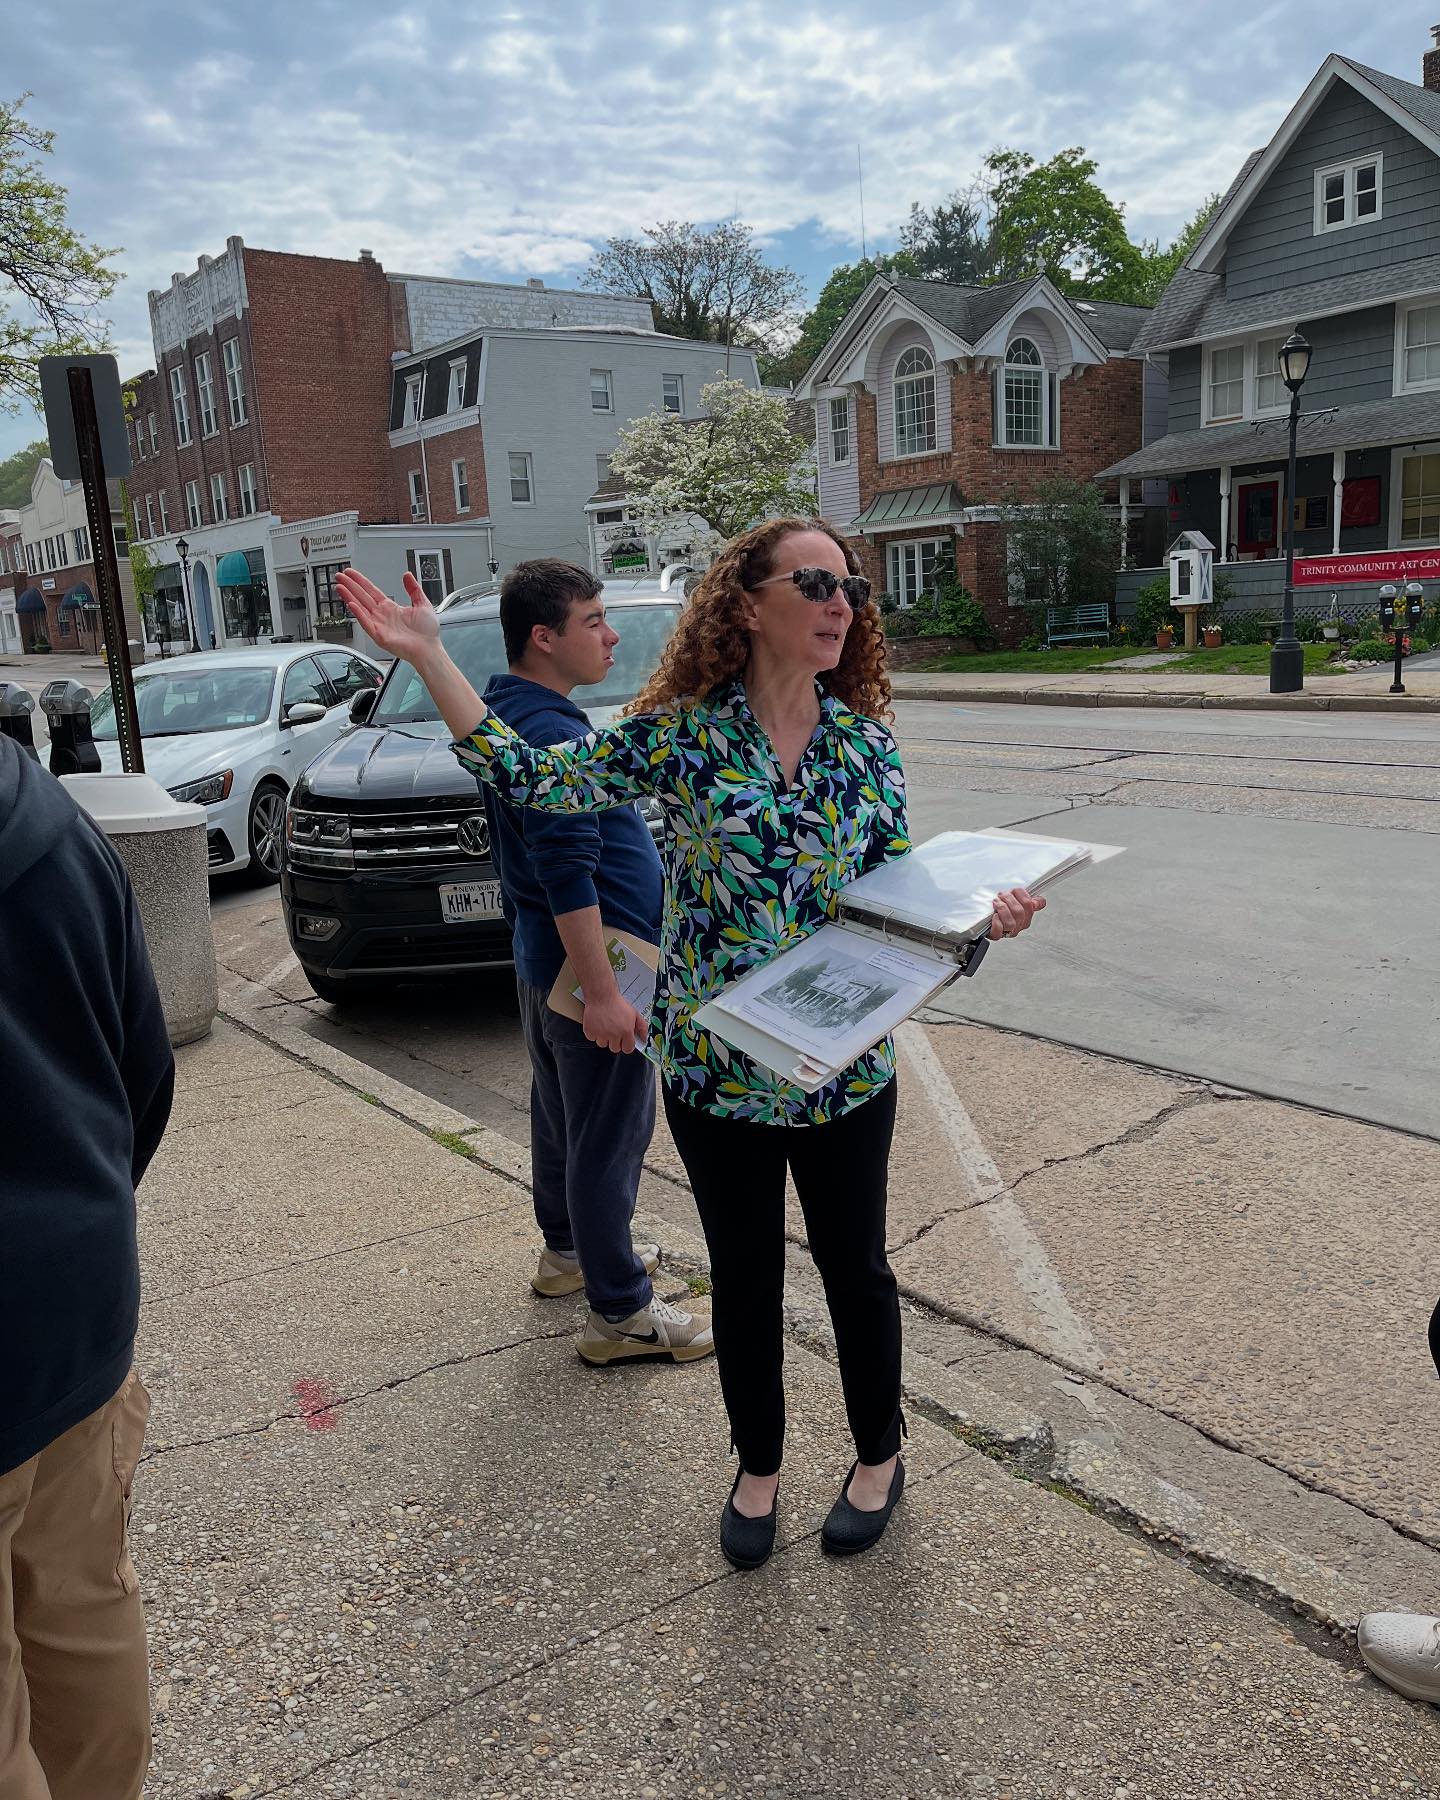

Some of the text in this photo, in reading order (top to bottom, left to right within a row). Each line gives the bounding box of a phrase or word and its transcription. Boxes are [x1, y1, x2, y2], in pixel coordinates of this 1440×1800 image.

[1301, 558, 1440, 576] TRINITY COMMUNITY ART CEN
[458, 883, 497, 893] NEW YORK
